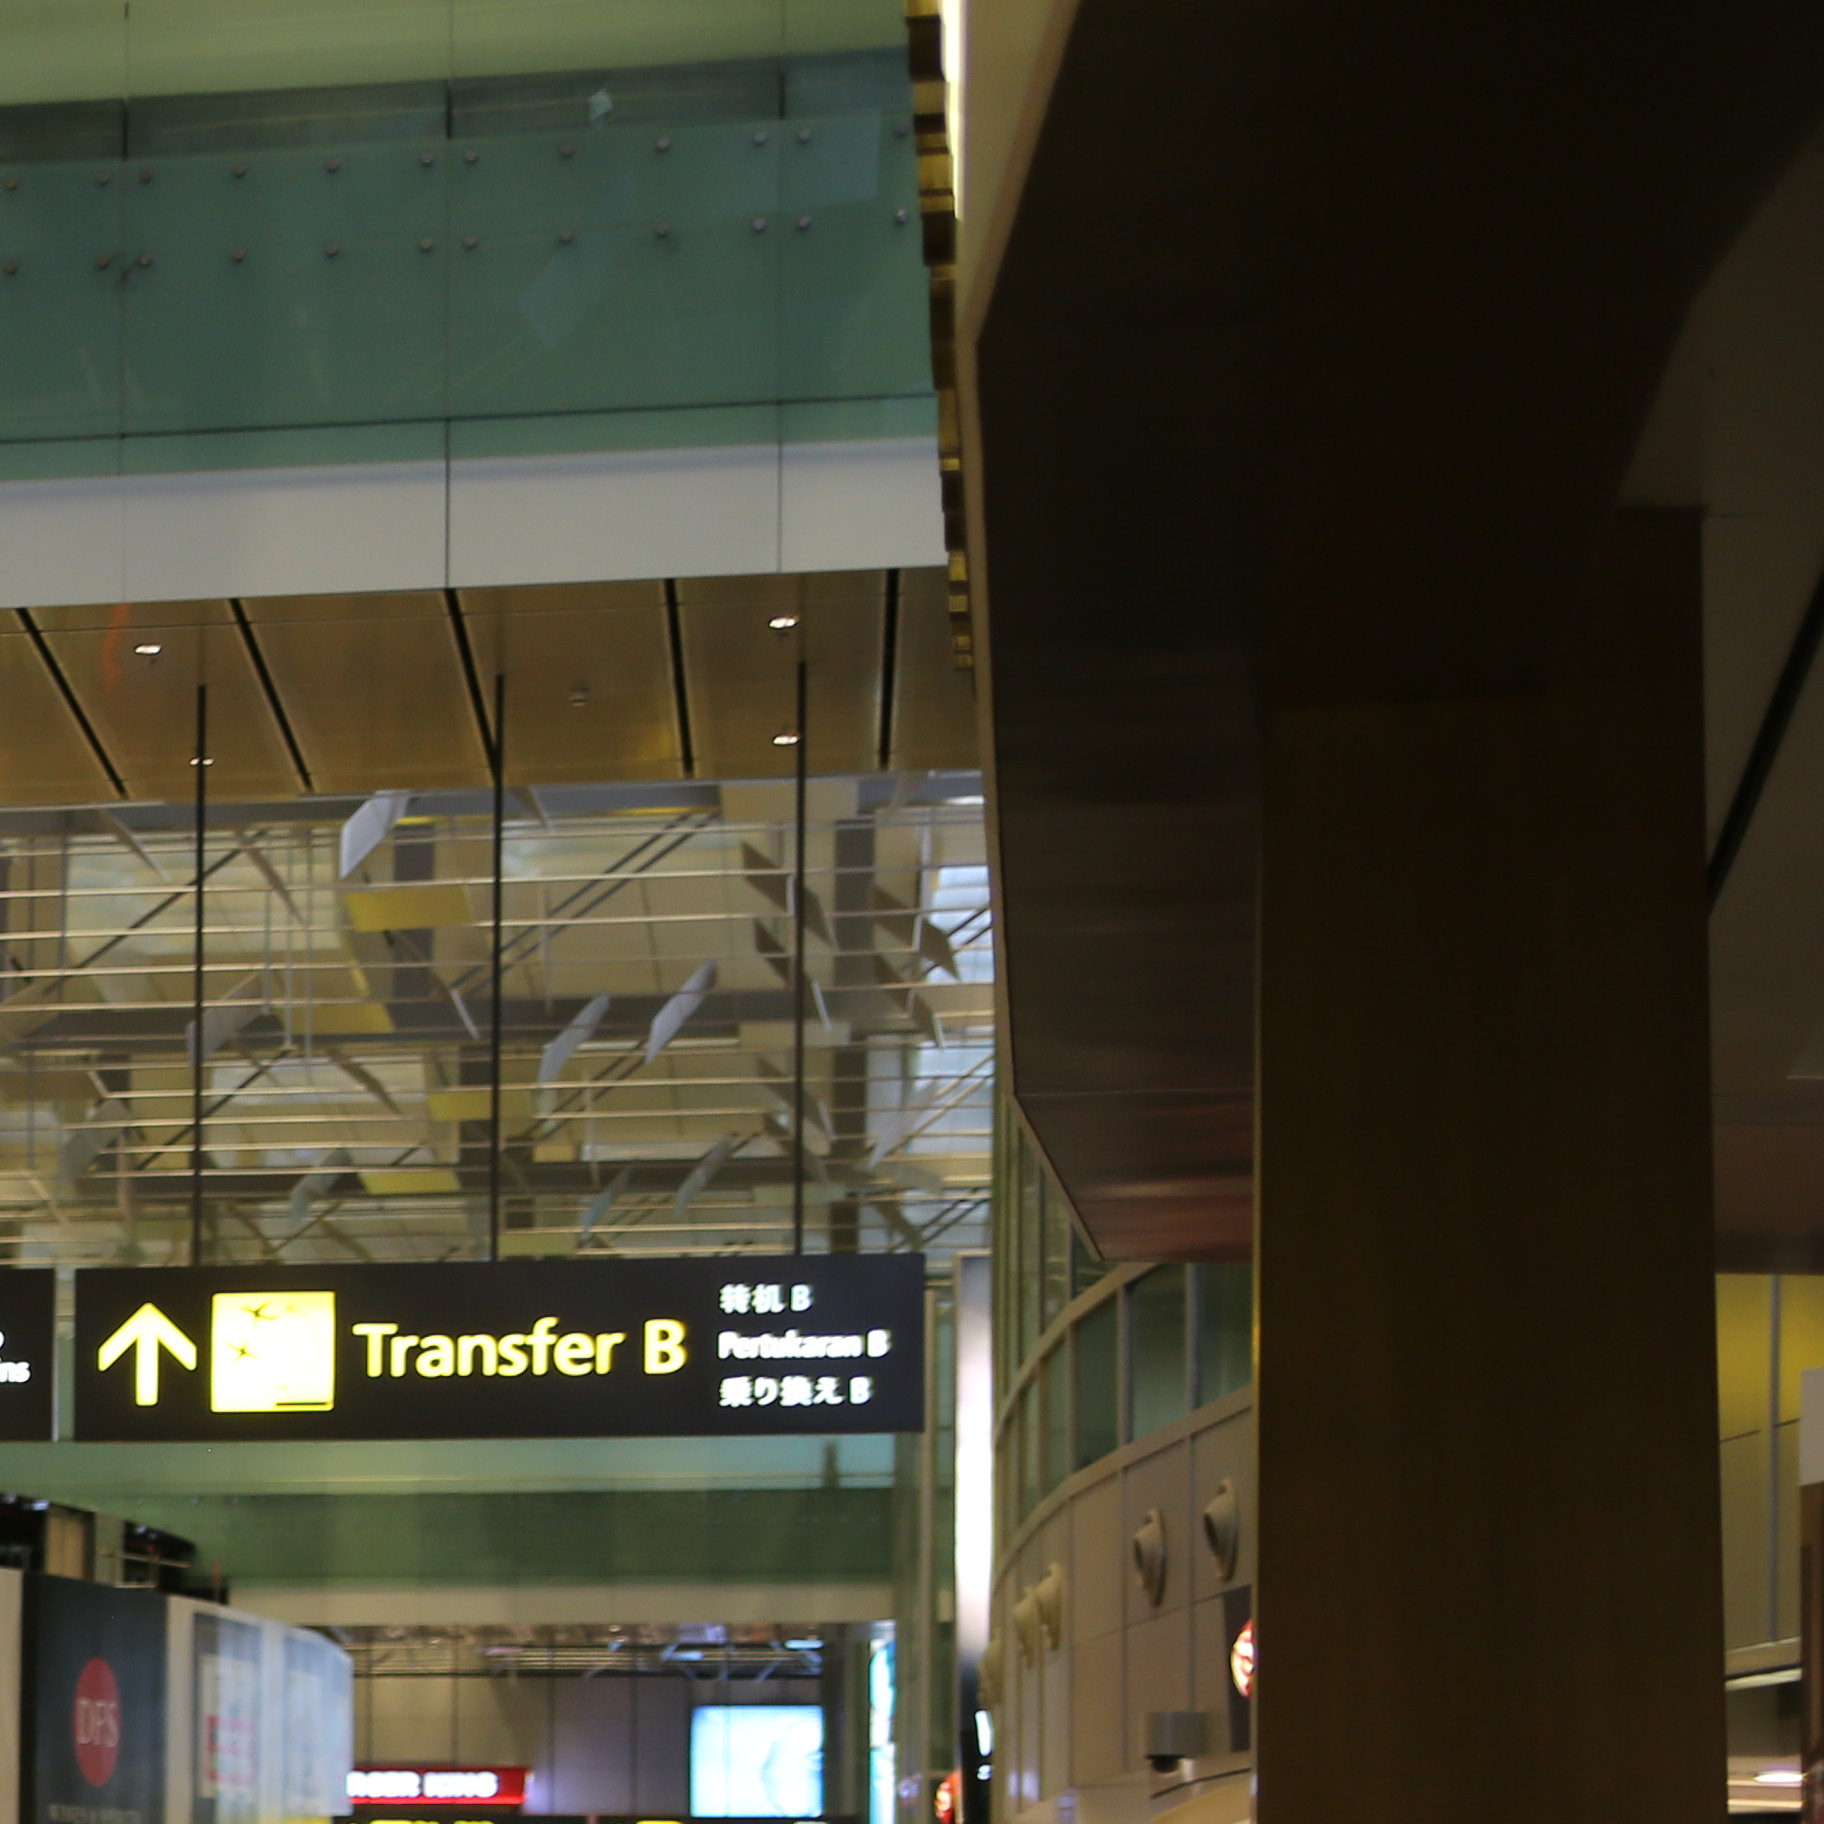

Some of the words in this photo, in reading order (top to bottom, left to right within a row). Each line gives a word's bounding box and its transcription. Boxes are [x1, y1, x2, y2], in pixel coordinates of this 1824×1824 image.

[790, 1284, 812, 1312] B
[351, 1316, 627, 1377] Transfer
[644, 1318, 688, 1375] B
[718, 1329, 864, 1359] Pertukaran
[867, 1329, 892, 1358] B
[849, 1376, 873, 1405] B
[76, 1698, 120, 1748] DFS
